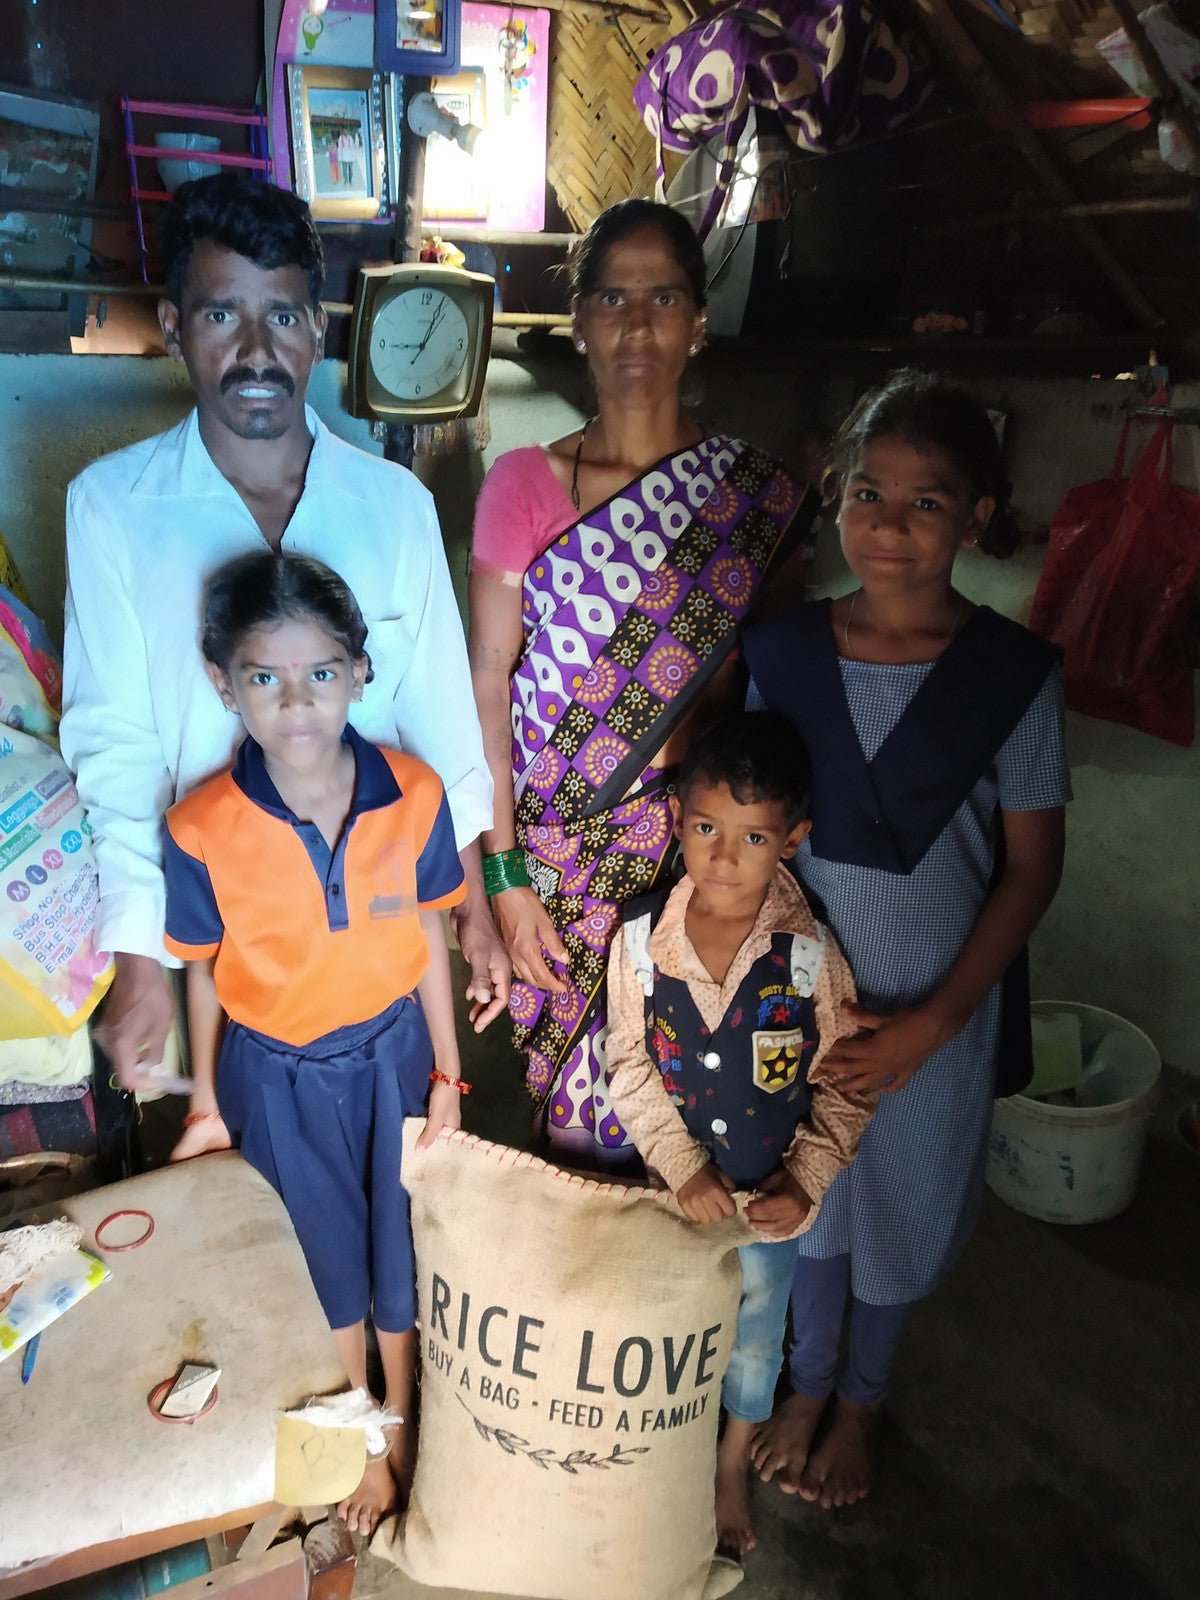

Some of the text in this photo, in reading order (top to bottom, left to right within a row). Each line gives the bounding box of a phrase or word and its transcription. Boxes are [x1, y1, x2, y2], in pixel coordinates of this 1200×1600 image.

[420, 292, 433, 306] 12
[379, 338, 386, 349] 9
[458, 338, 464, 350] 3
[415, 385, 421, 395] 6
[12, 833, 81, 900] M L XL XXL
[13, 912, 40, 940] Shop
[24, 929, 46, 952] Bus
[44, 904, 67, 929] Stop
[45, 940, 76, 974] E-mail
[429, 1271, 722, 1398] RICE LOVE
[428, 1338, 453, 1376] BUY
[460, 1366, 471, 1390] A
[479, 1376, 521, 1410] BAG
[549, 1399, 603, 1429] FEED
[615, 1410, 630, 1432] A
[641, 1391, 709, 1433] FAMILY
